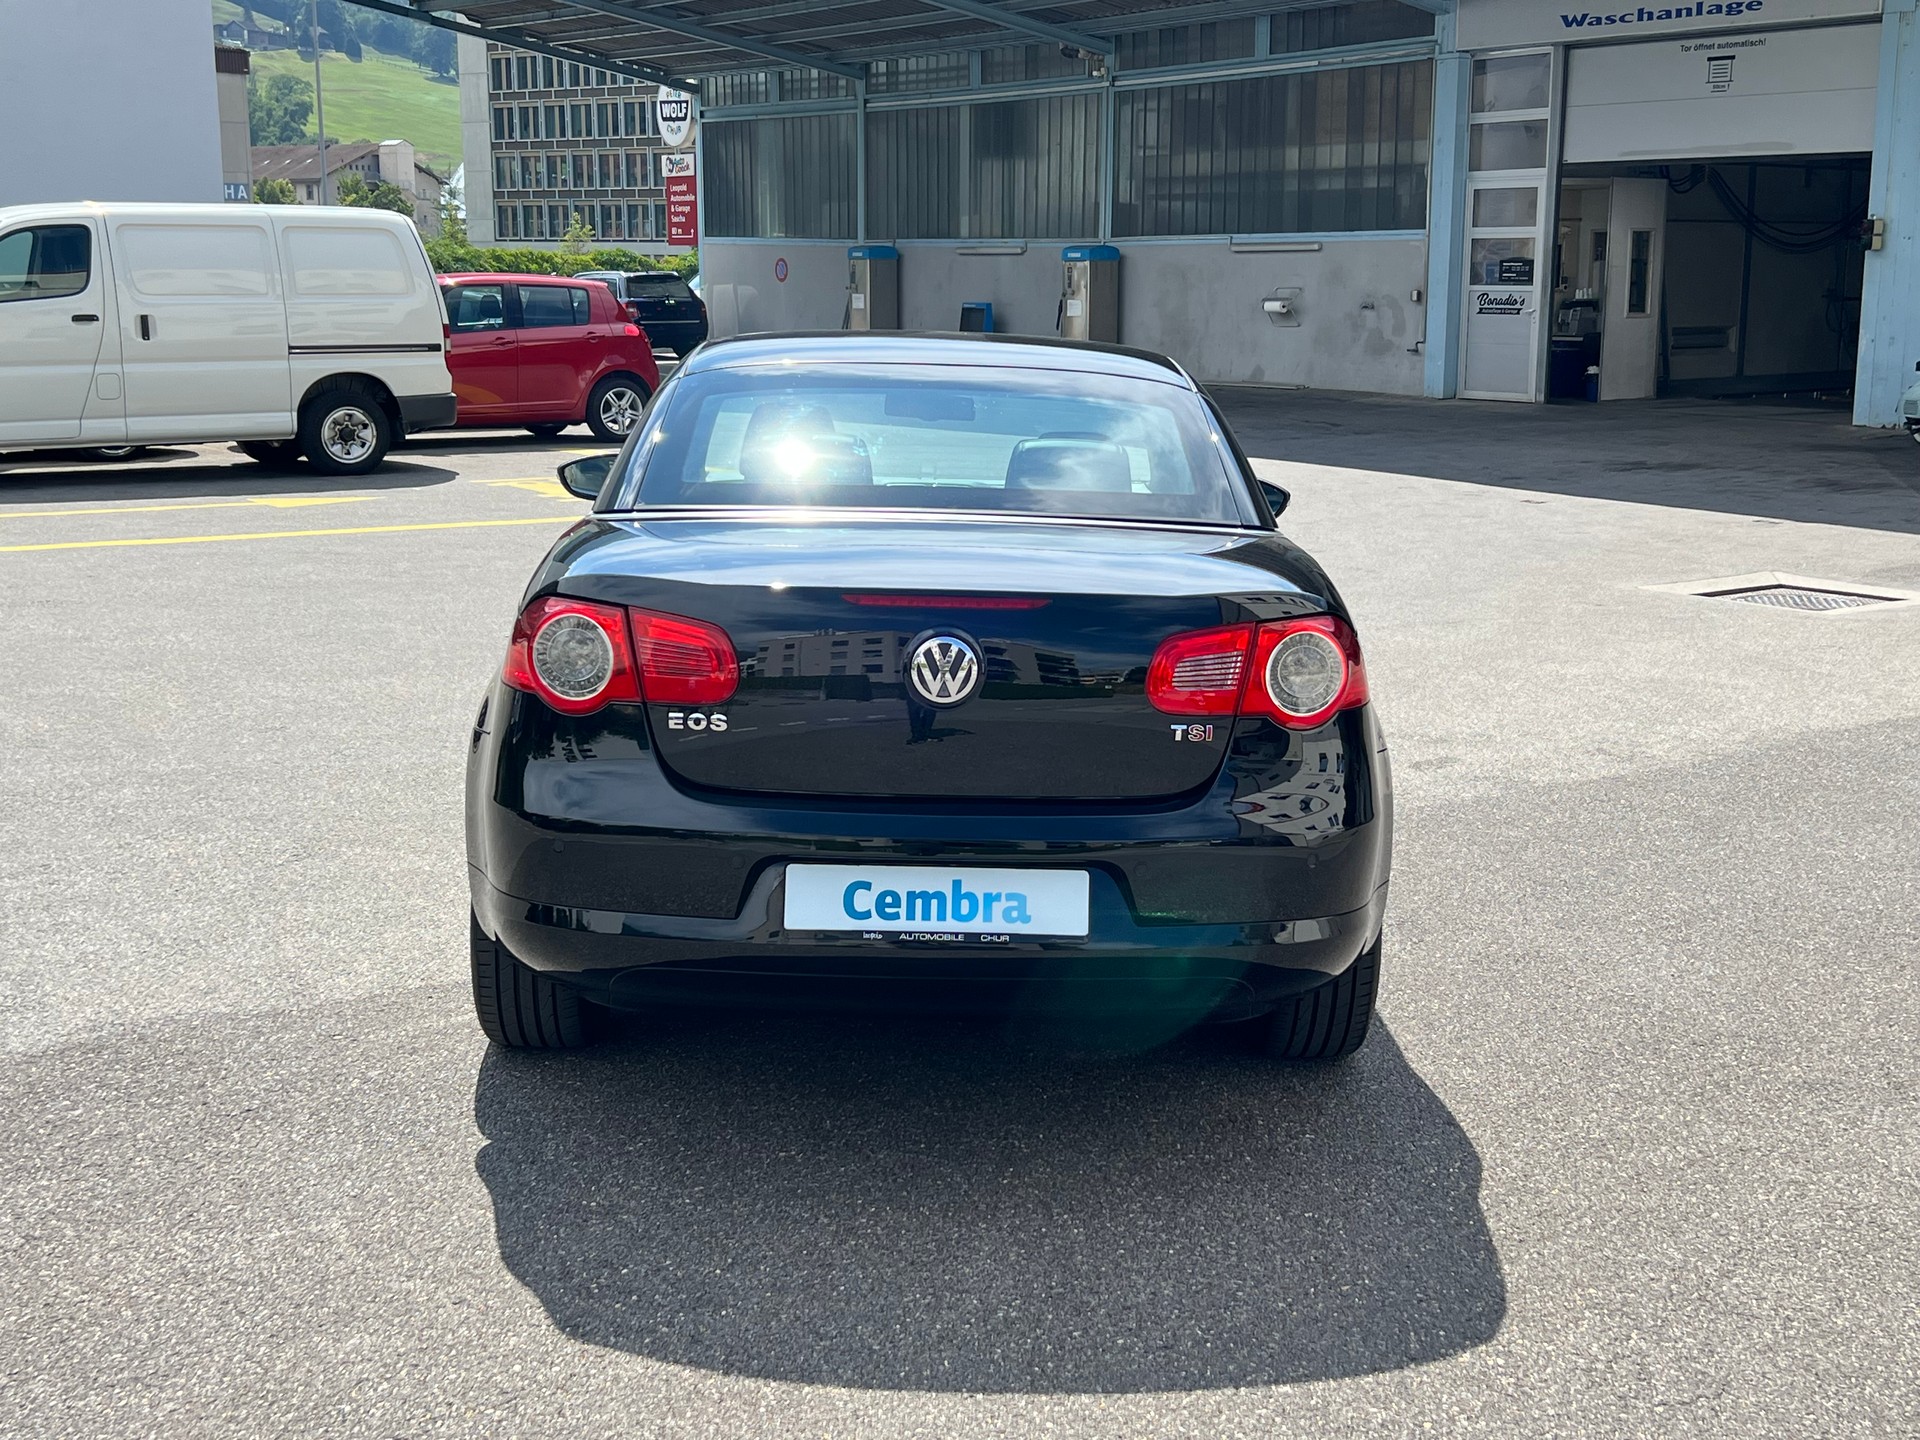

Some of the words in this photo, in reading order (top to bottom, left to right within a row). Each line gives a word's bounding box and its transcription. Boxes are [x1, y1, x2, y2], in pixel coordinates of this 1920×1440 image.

[1560, 0, 1763, 28] Waschanlage
[1680, 44, 1693, 53] Tor
[1693, 42, 1715, 52] öffnet
[1716, 38, 1767, 50] automatisch!
[661, 102, 687, 118] WOLF
[670, 193, 696, 202] Automobile
[1477, 292, 1526, 307] Bonadio's
[668, 712, 728, 732] EOS
[1170, 724, 1213, 741] TSI
[843, 879, 1031, 924] Cembra
[899, 932, 965, 941] AUTOMOBILE
[980, 934, 1010, 942] CHUR
